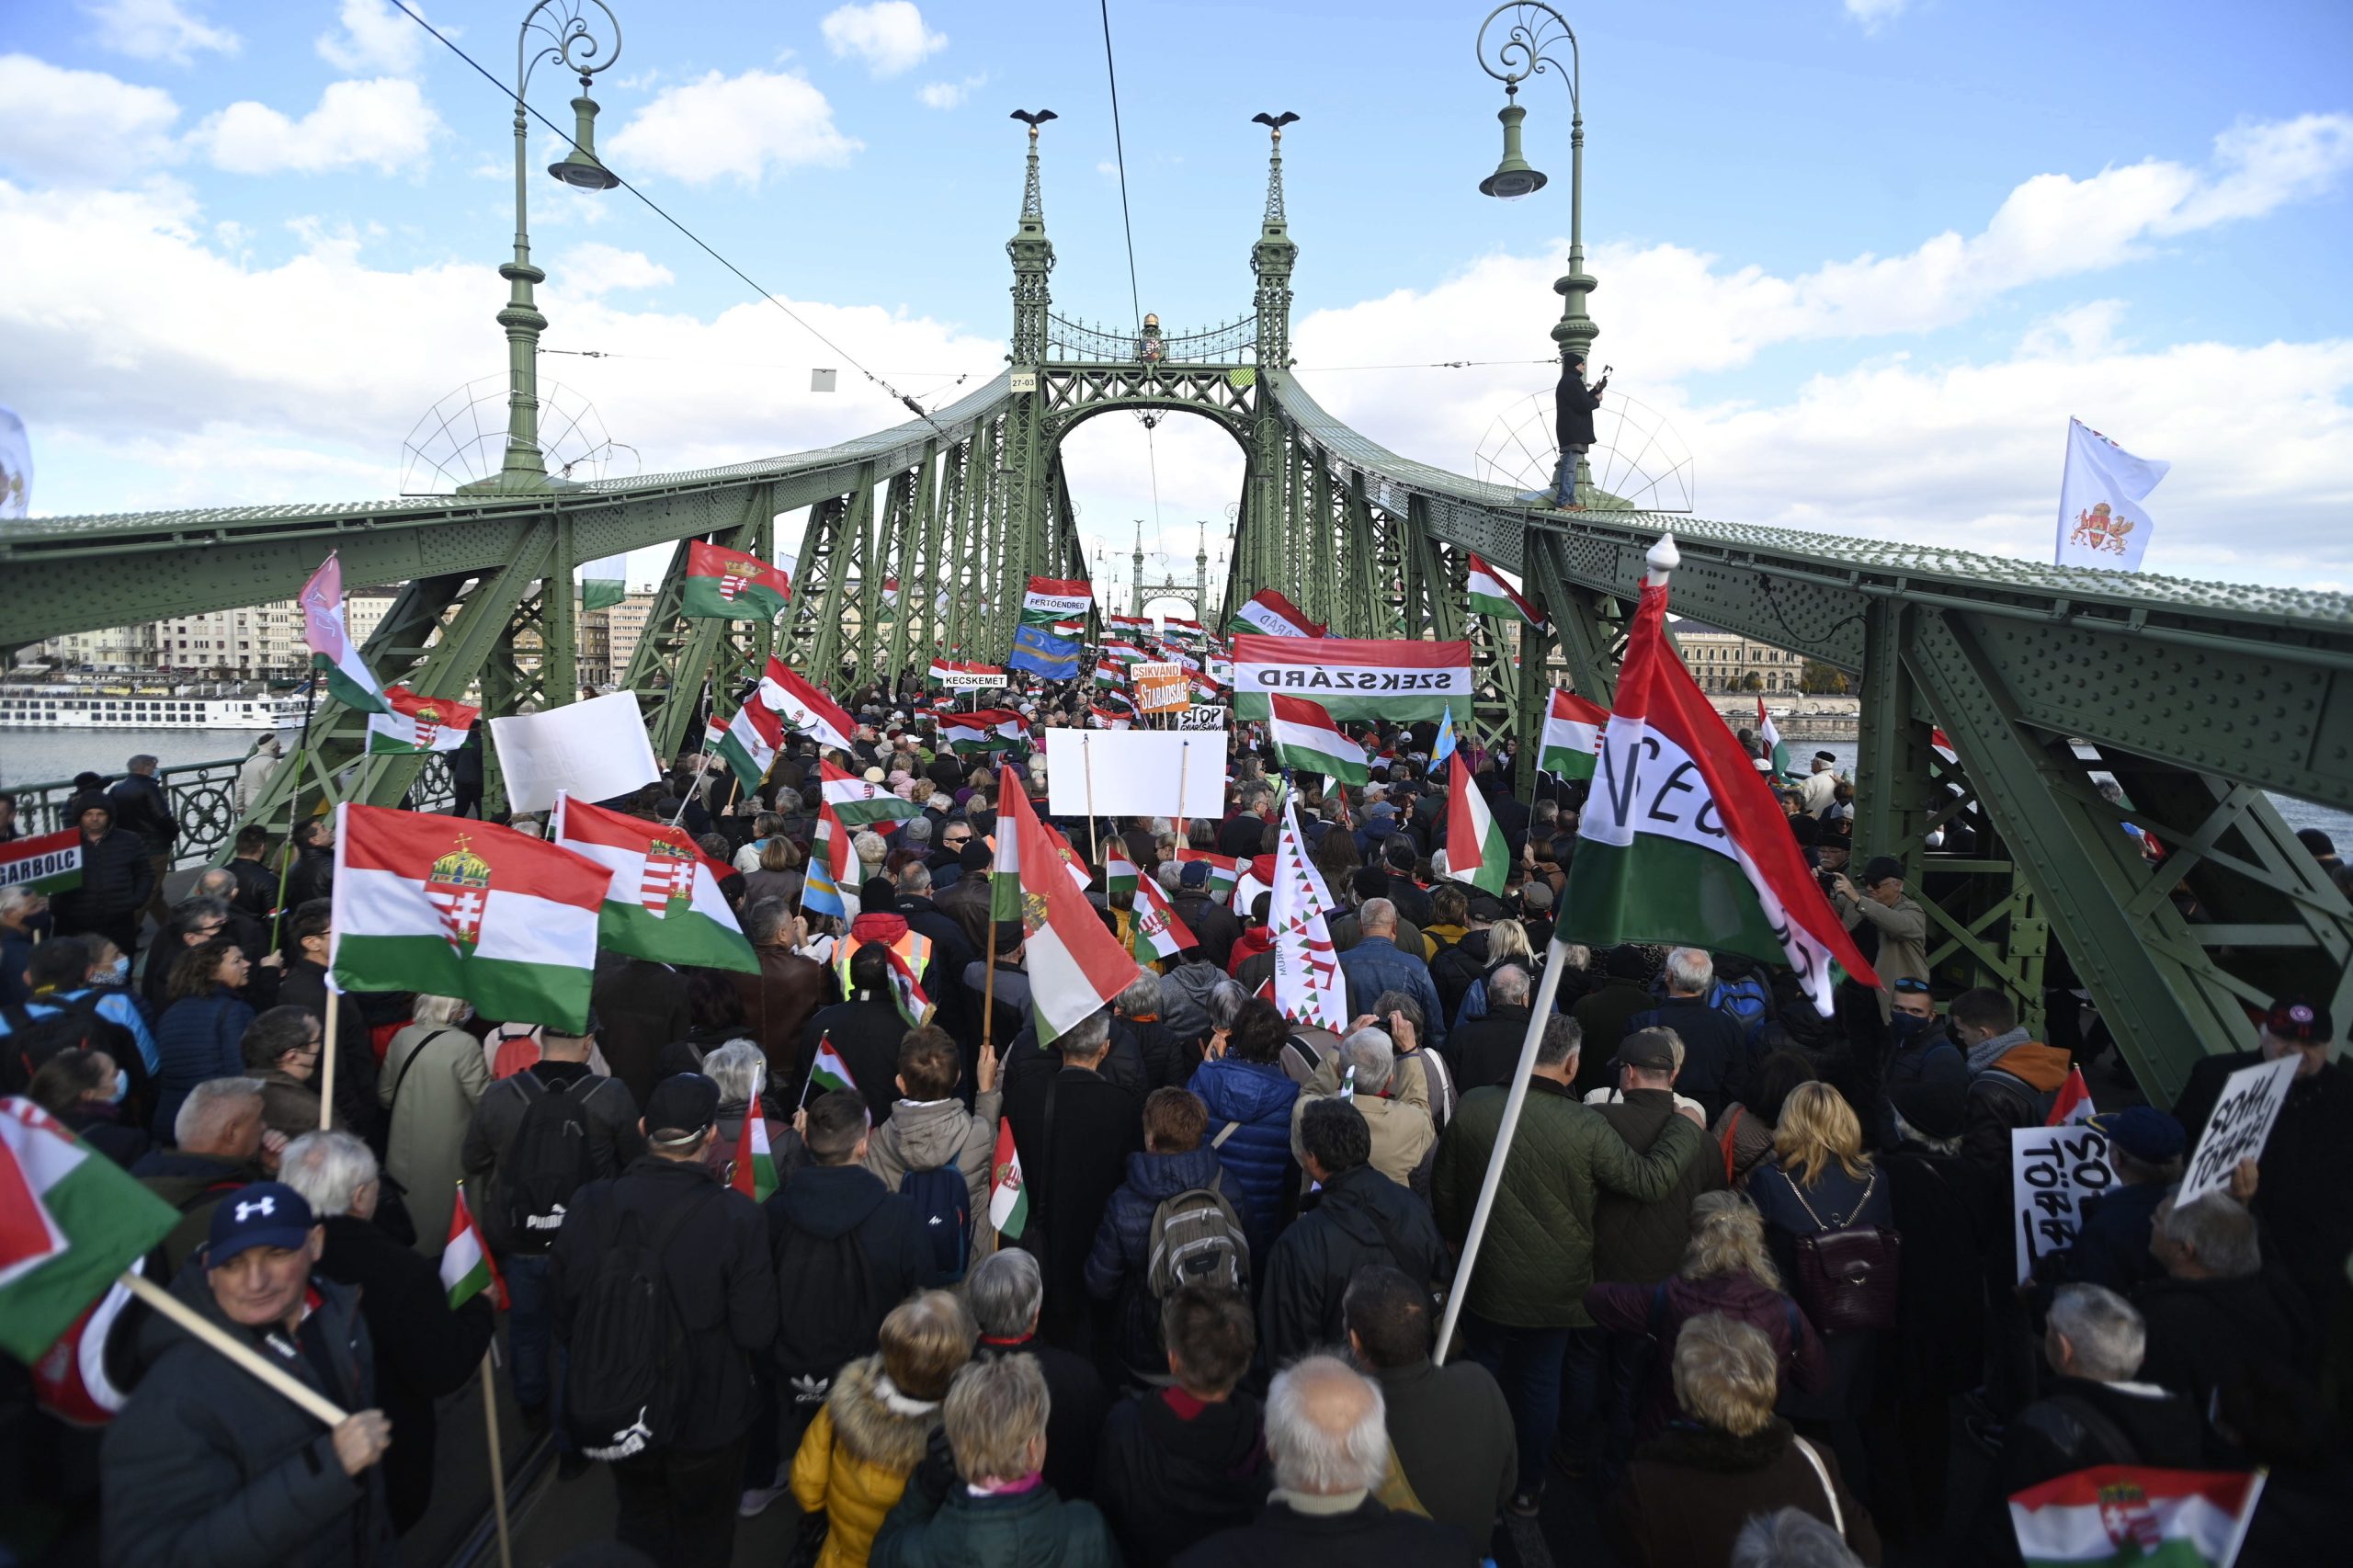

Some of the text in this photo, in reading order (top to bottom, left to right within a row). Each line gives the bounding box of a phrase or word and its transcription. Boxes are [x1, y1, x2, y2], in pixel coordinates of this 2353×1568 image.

[1012, 379, 1034, 387] 27-03
[1132, 663, 1178, 677] CSIKVÁND
[946, 676, 1004, 686] KECSKEMÉT
[1181, 706, 1221, 724] STOP
[2022, 1137, 2079, 1247] TÖBB
